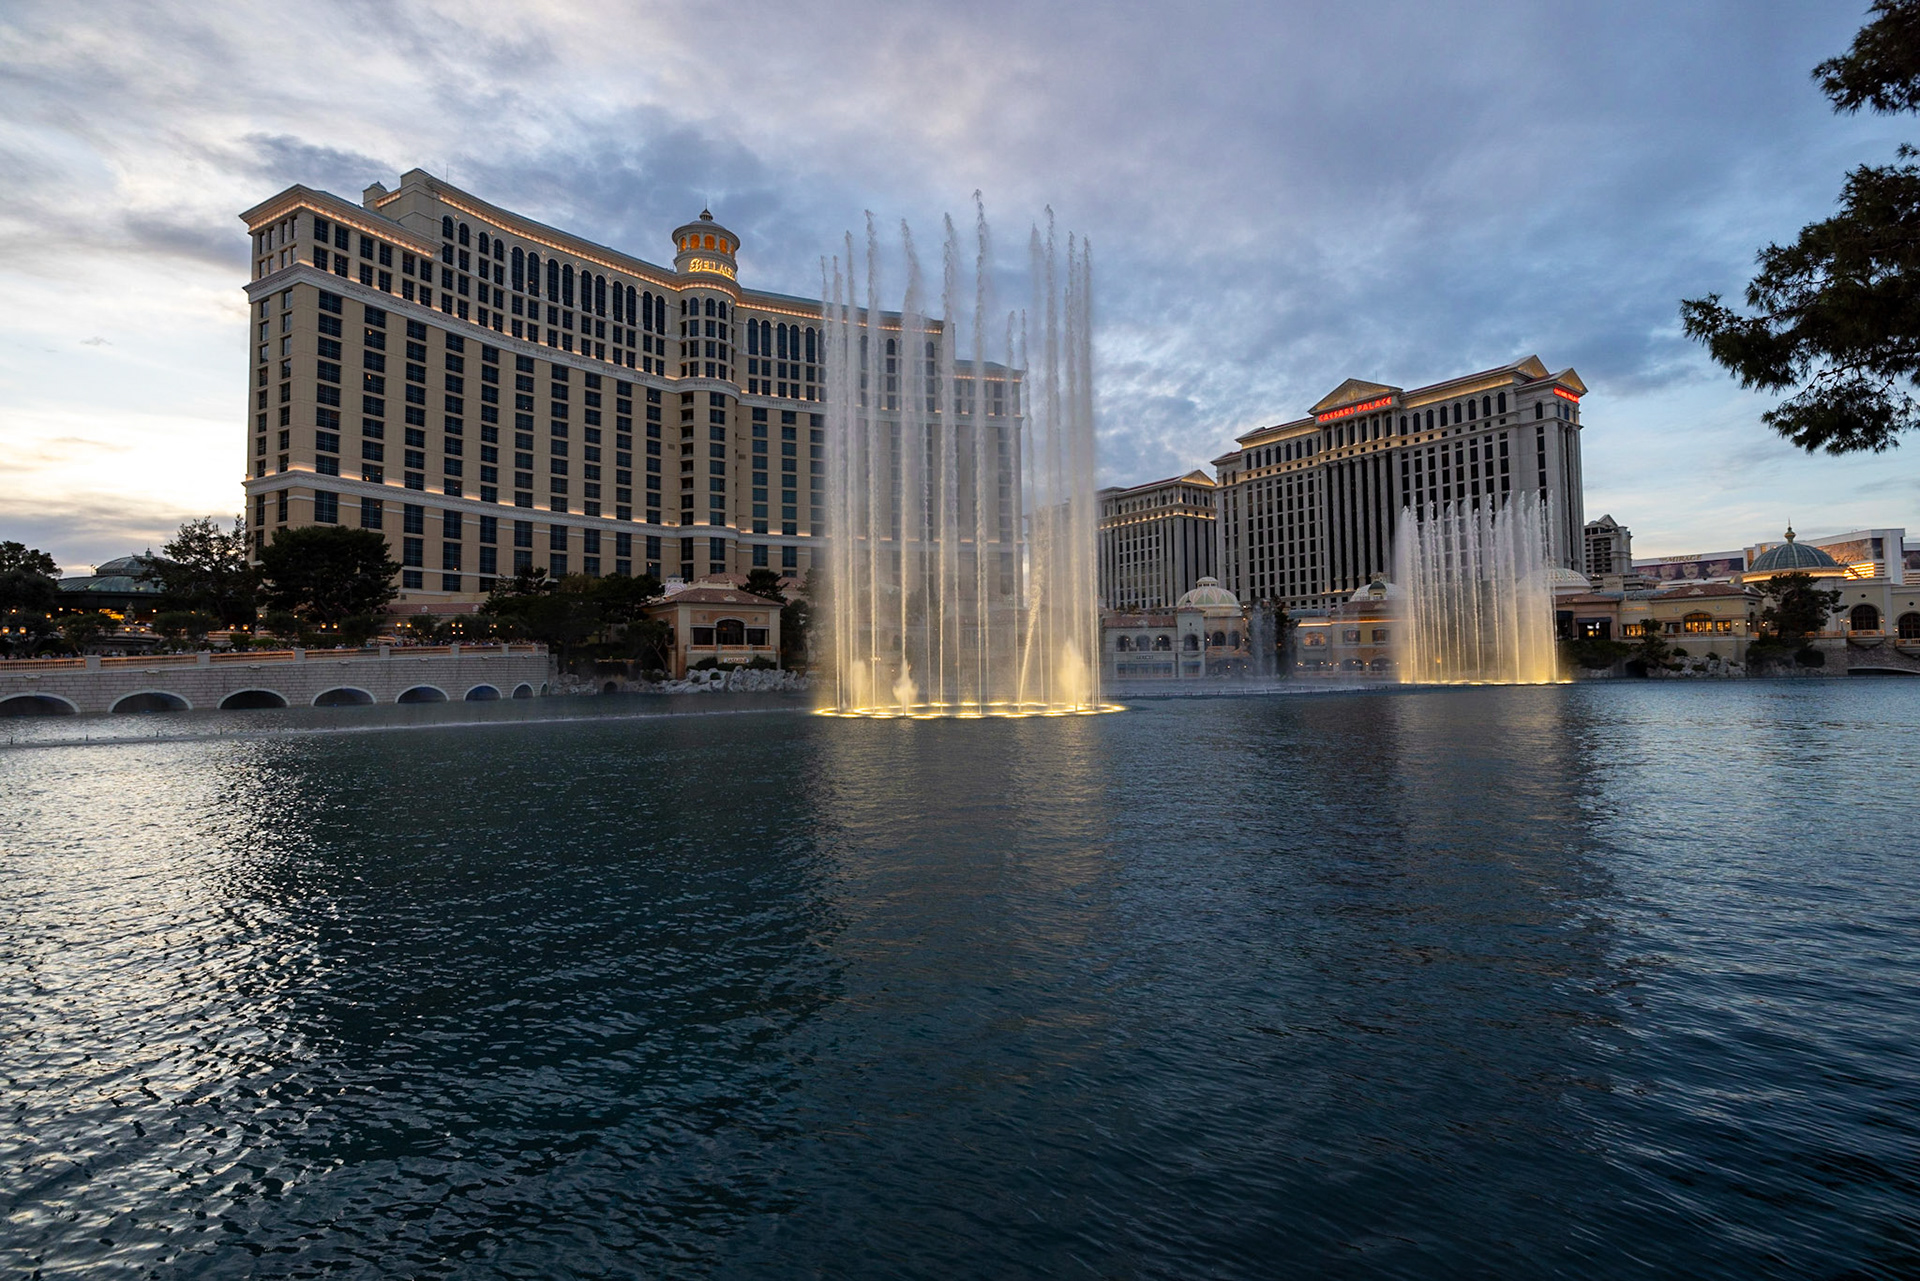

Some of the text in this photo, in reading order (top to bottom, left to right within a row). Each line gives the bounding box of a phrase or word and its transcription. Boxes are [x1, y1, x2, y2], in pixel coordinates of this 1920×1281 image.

[1318, 396, 1392, 422] CAESARS PALACE
[1668, 554, 1702, 563] MIRAGE
